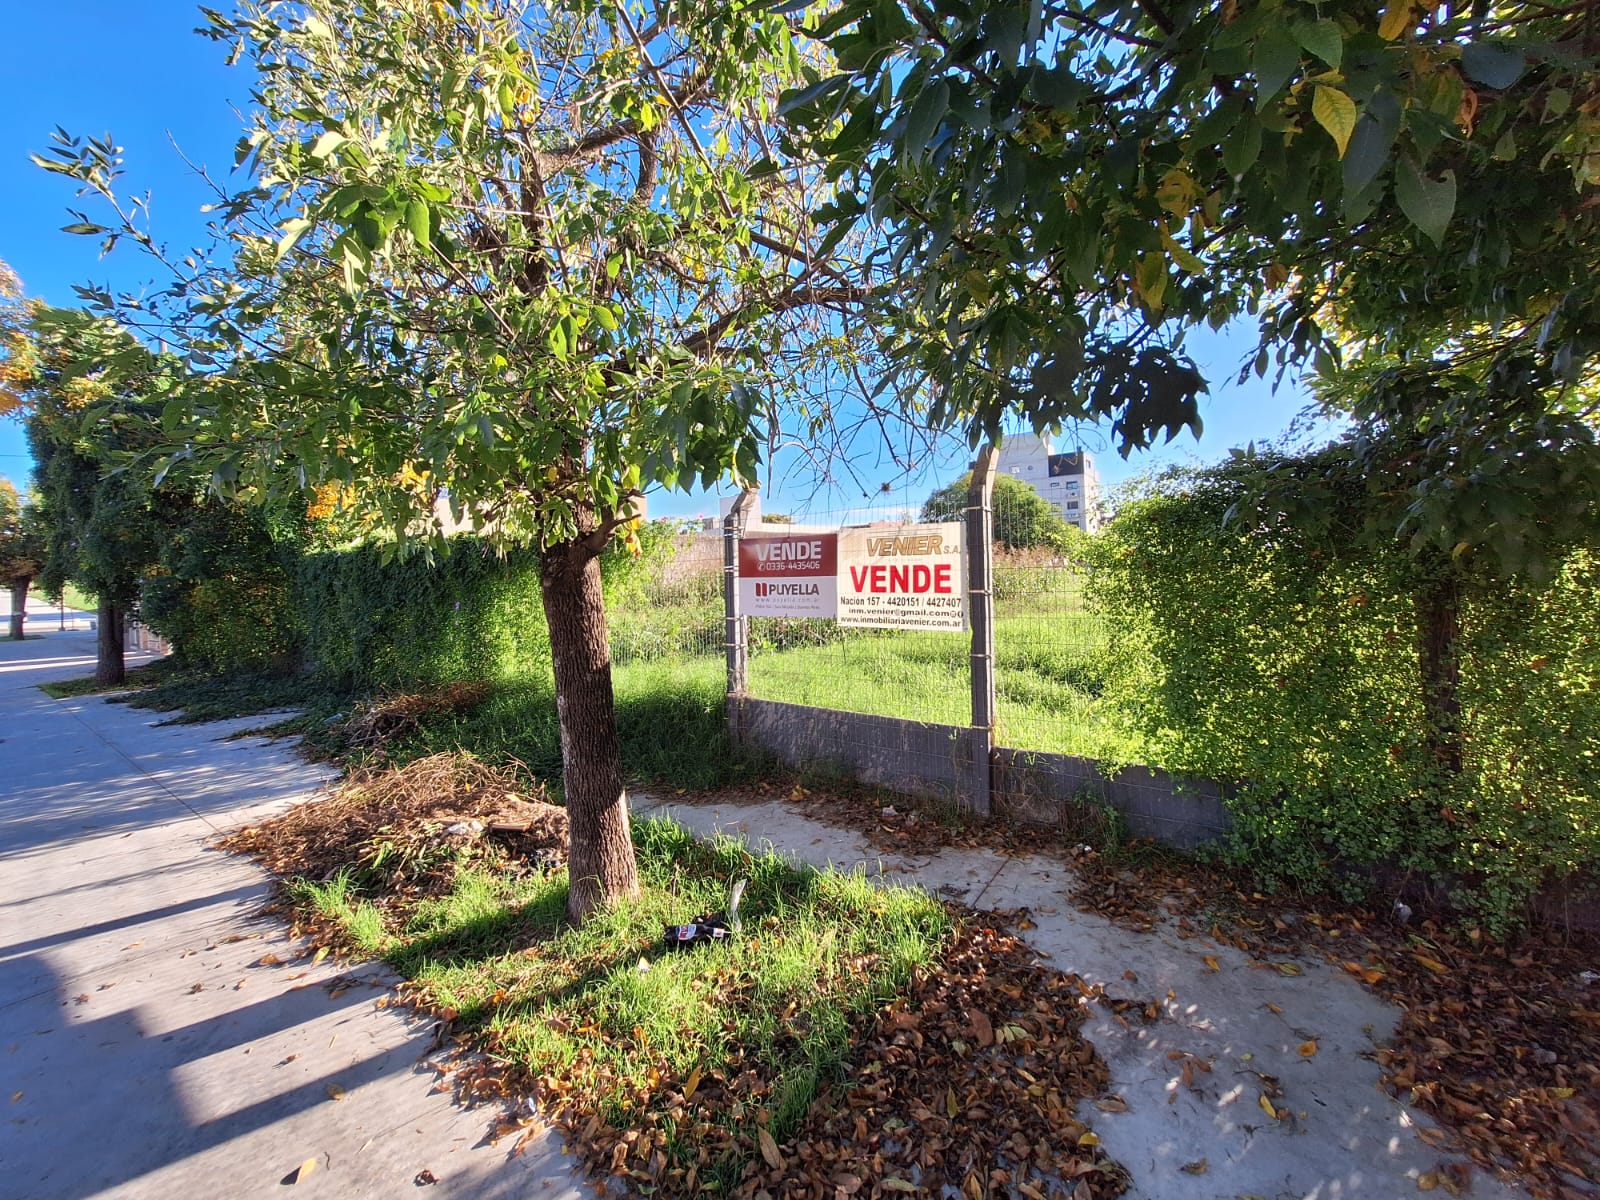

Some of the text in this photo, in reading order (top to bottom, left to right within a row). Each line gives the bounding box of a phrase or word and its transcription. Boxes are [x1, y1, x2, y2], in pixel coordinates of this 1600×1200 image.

[756, 541, 821, 561] VENDE
[866, 535, 962, 557] VENIER S.A.
[850, 564, 952, 593] VENDE
[769, 584, 820, 596] PUYELLA
[867, 597, 880, 606] 157
[887, 597, 919, 607] 4420151
[926, 598, 962, 608] 4427407
[849, 608, 950, 617] inm.venier@gmail.com
[840, 616, 962, 627] www.inmobiliariavenier.com.ar
